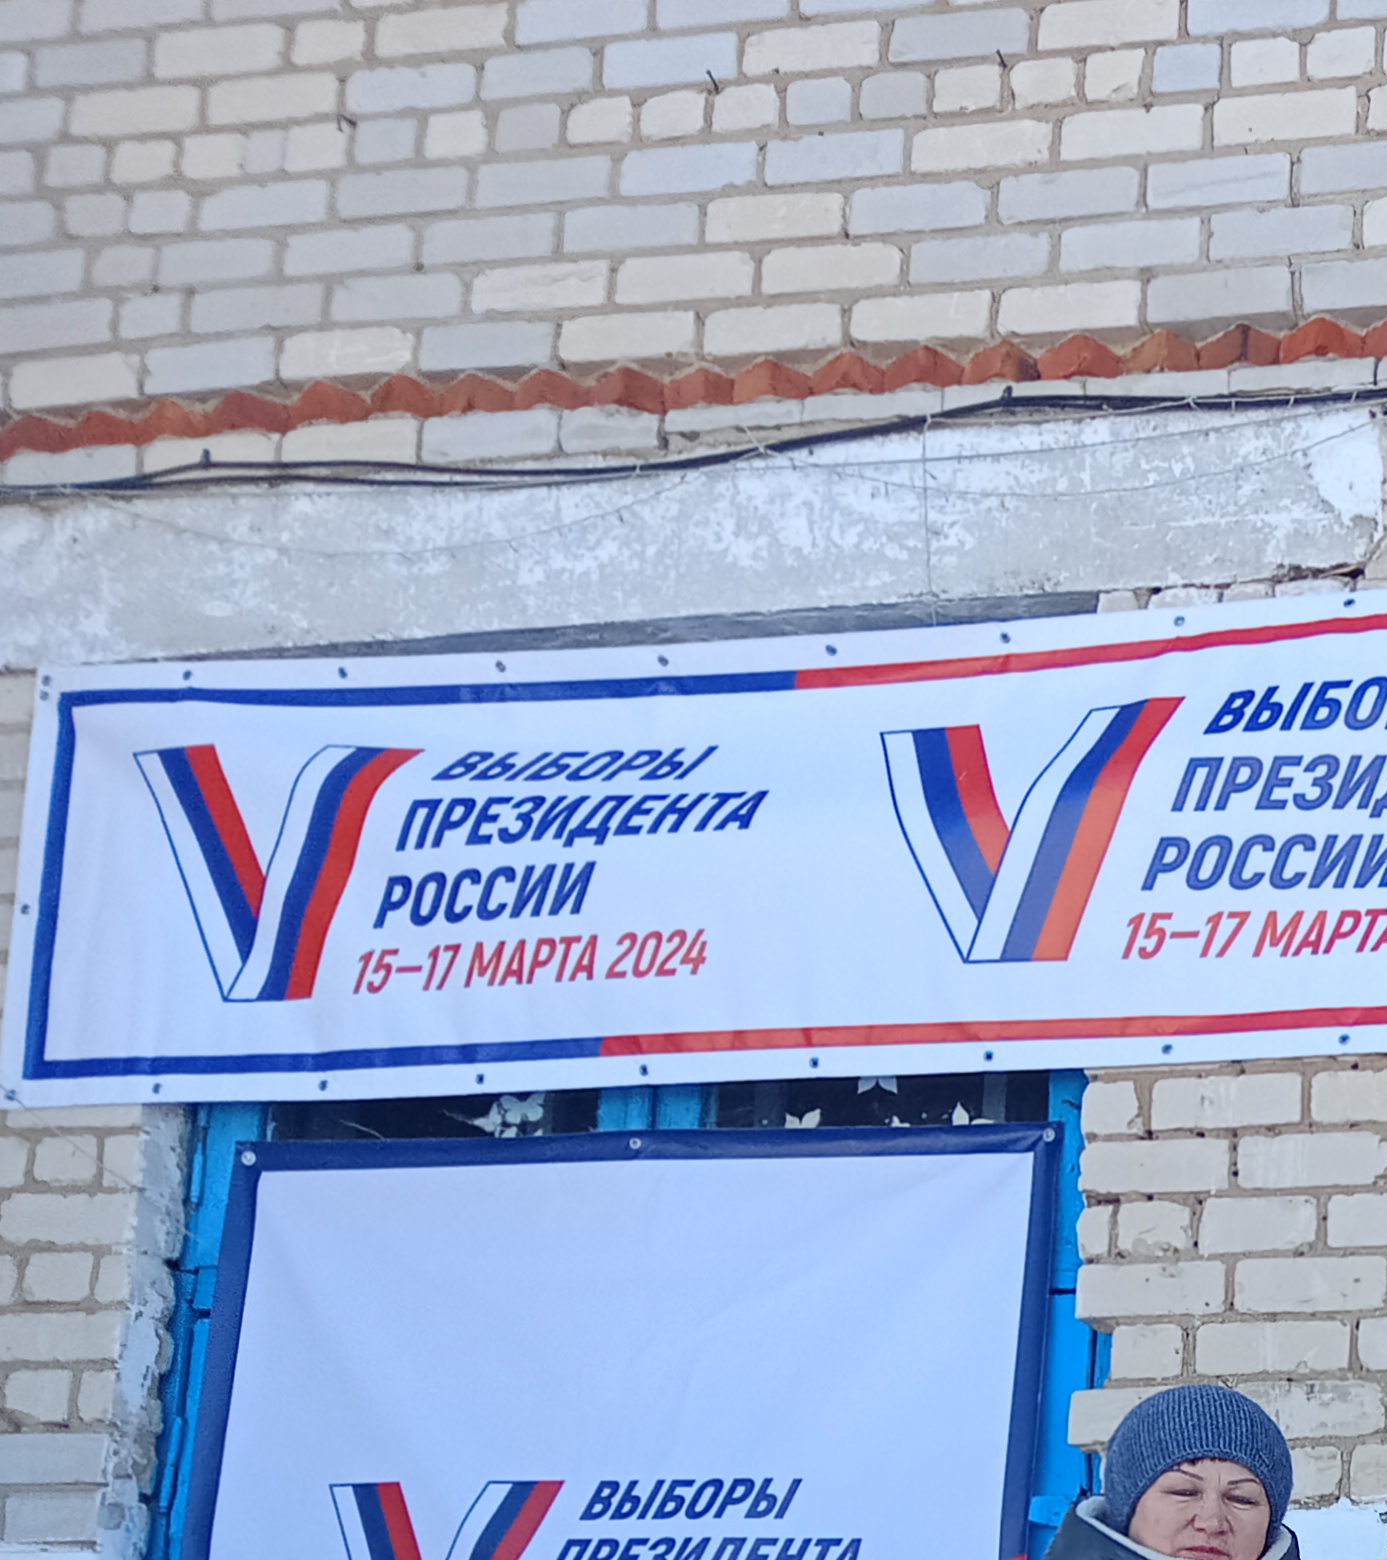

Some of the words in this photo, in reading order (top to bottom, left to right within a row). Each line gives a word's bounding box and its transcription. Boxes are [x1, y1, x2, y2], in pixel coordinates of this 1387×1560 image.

[433, 745, 719, 783] ВЫБОРЫ
[396, 789, 769, 852] ПРЕЗИДЕНТА
[373, 861, 596, 930] РОССИИ
[464, 933, 597, 989] МАРТА
[605, 928, 708, 981] 2024
[579, 1477, 803, 1521] ВЫБОРЫ
